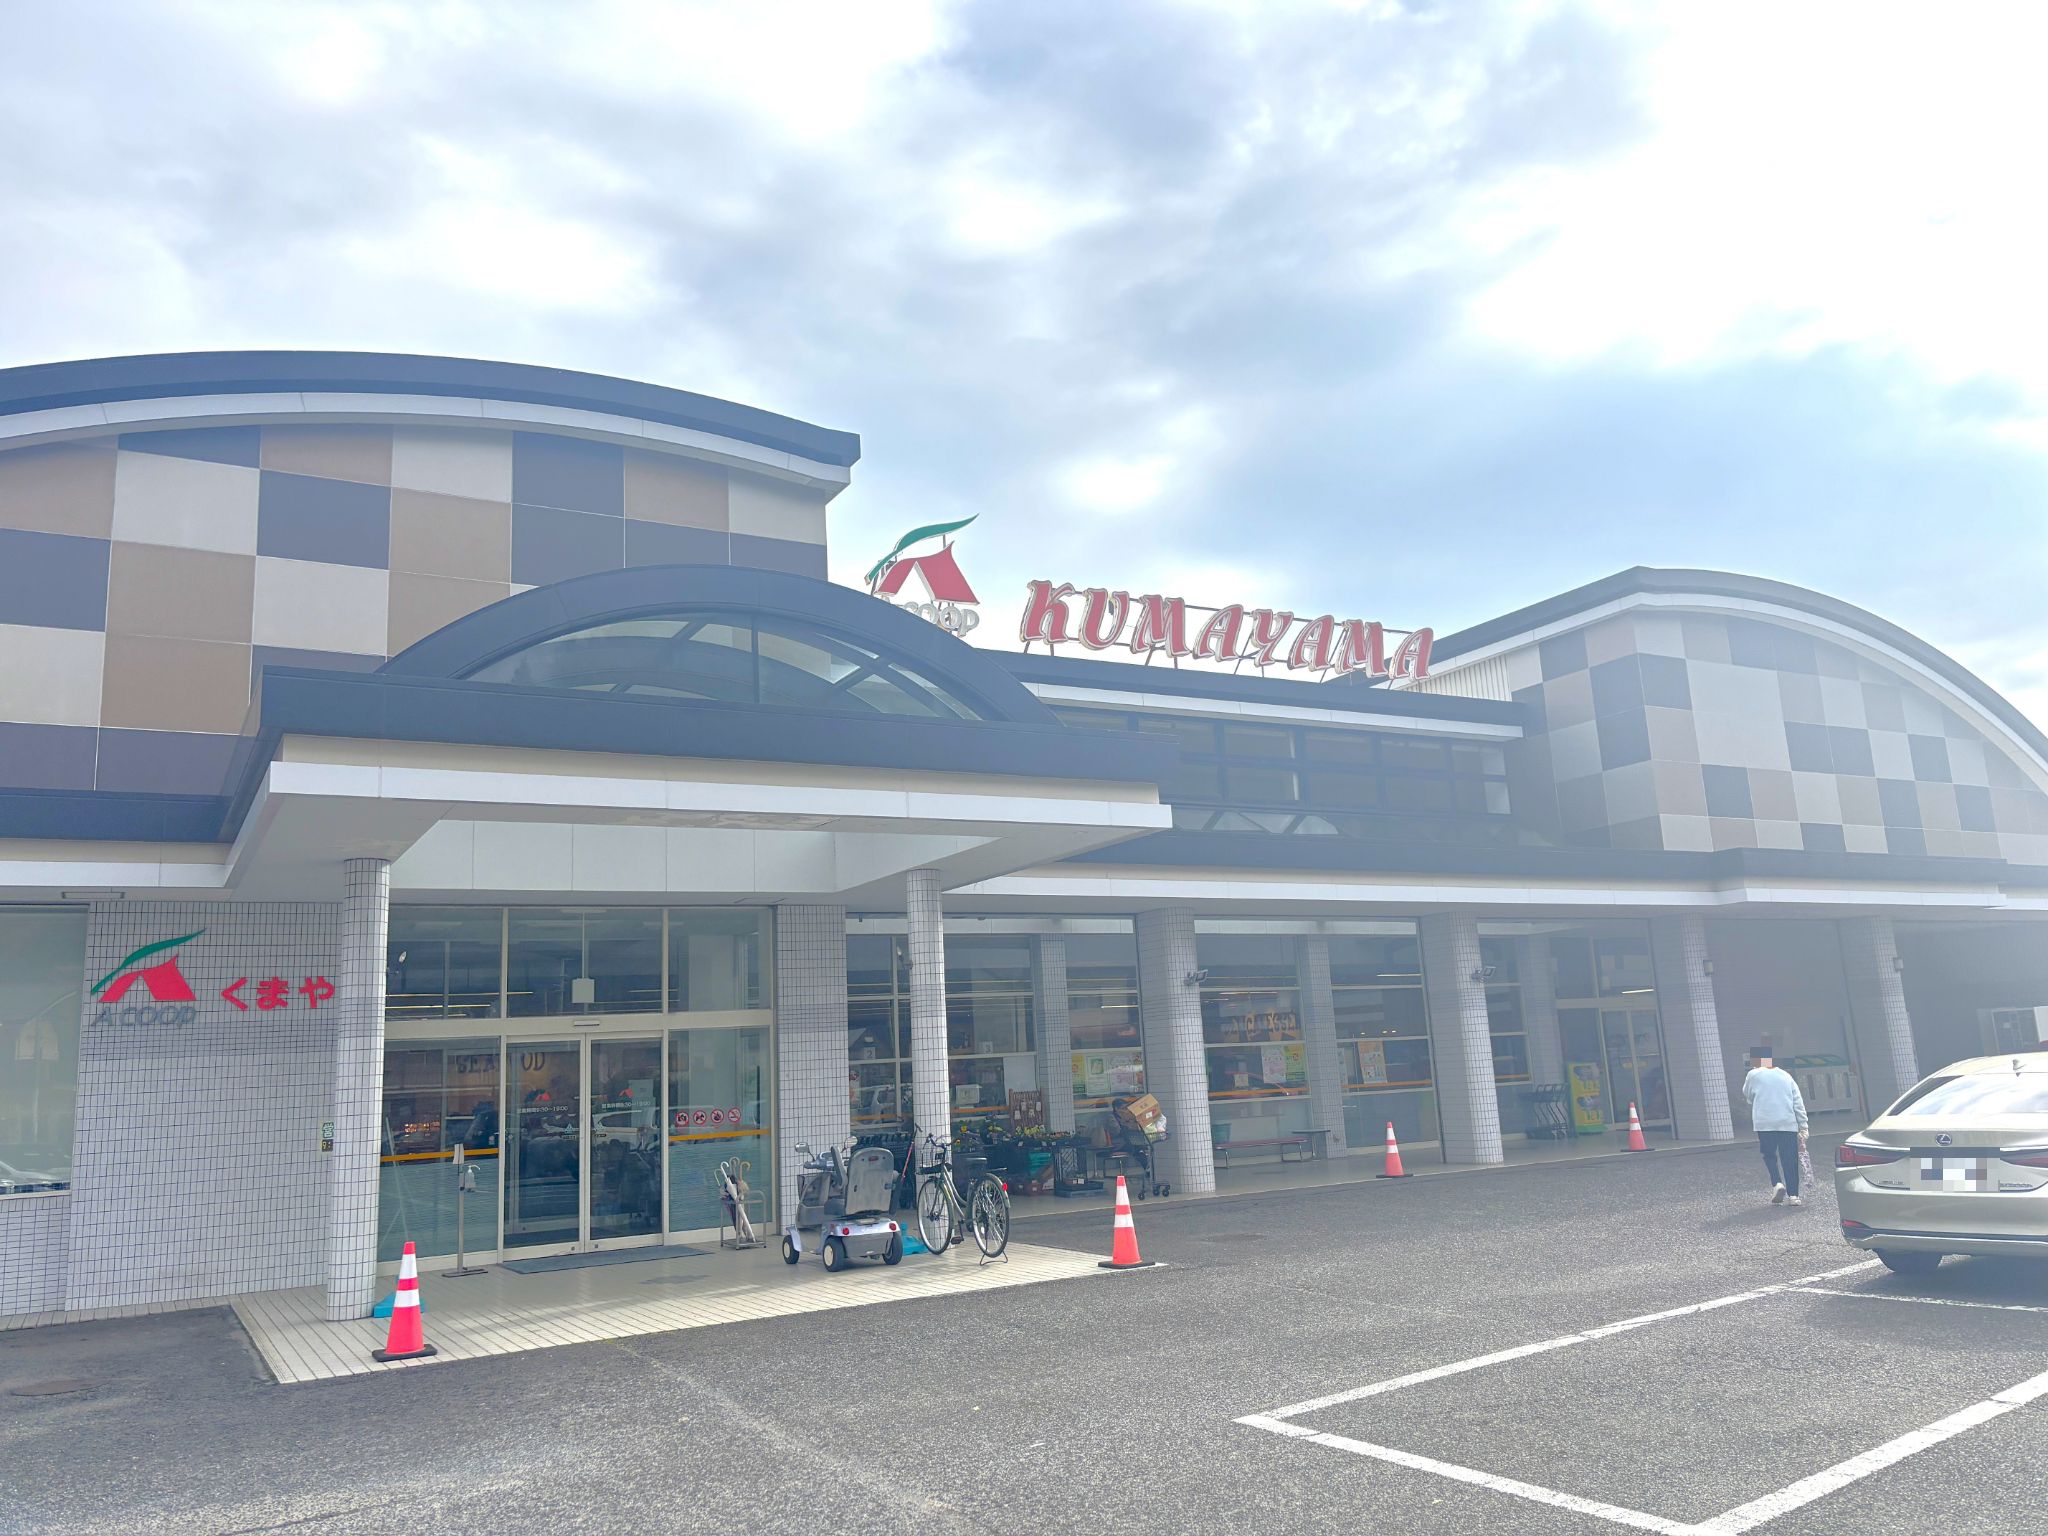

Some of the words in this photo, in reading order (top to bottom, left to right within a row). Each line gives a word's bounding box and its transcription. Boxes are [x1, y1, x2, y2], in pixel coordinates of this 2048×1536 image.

[1020, 579, 1433, 680] KUMAYAMA
[220, 975, 336, 1012] くまや
[91, 1006, 113, 1027] A
